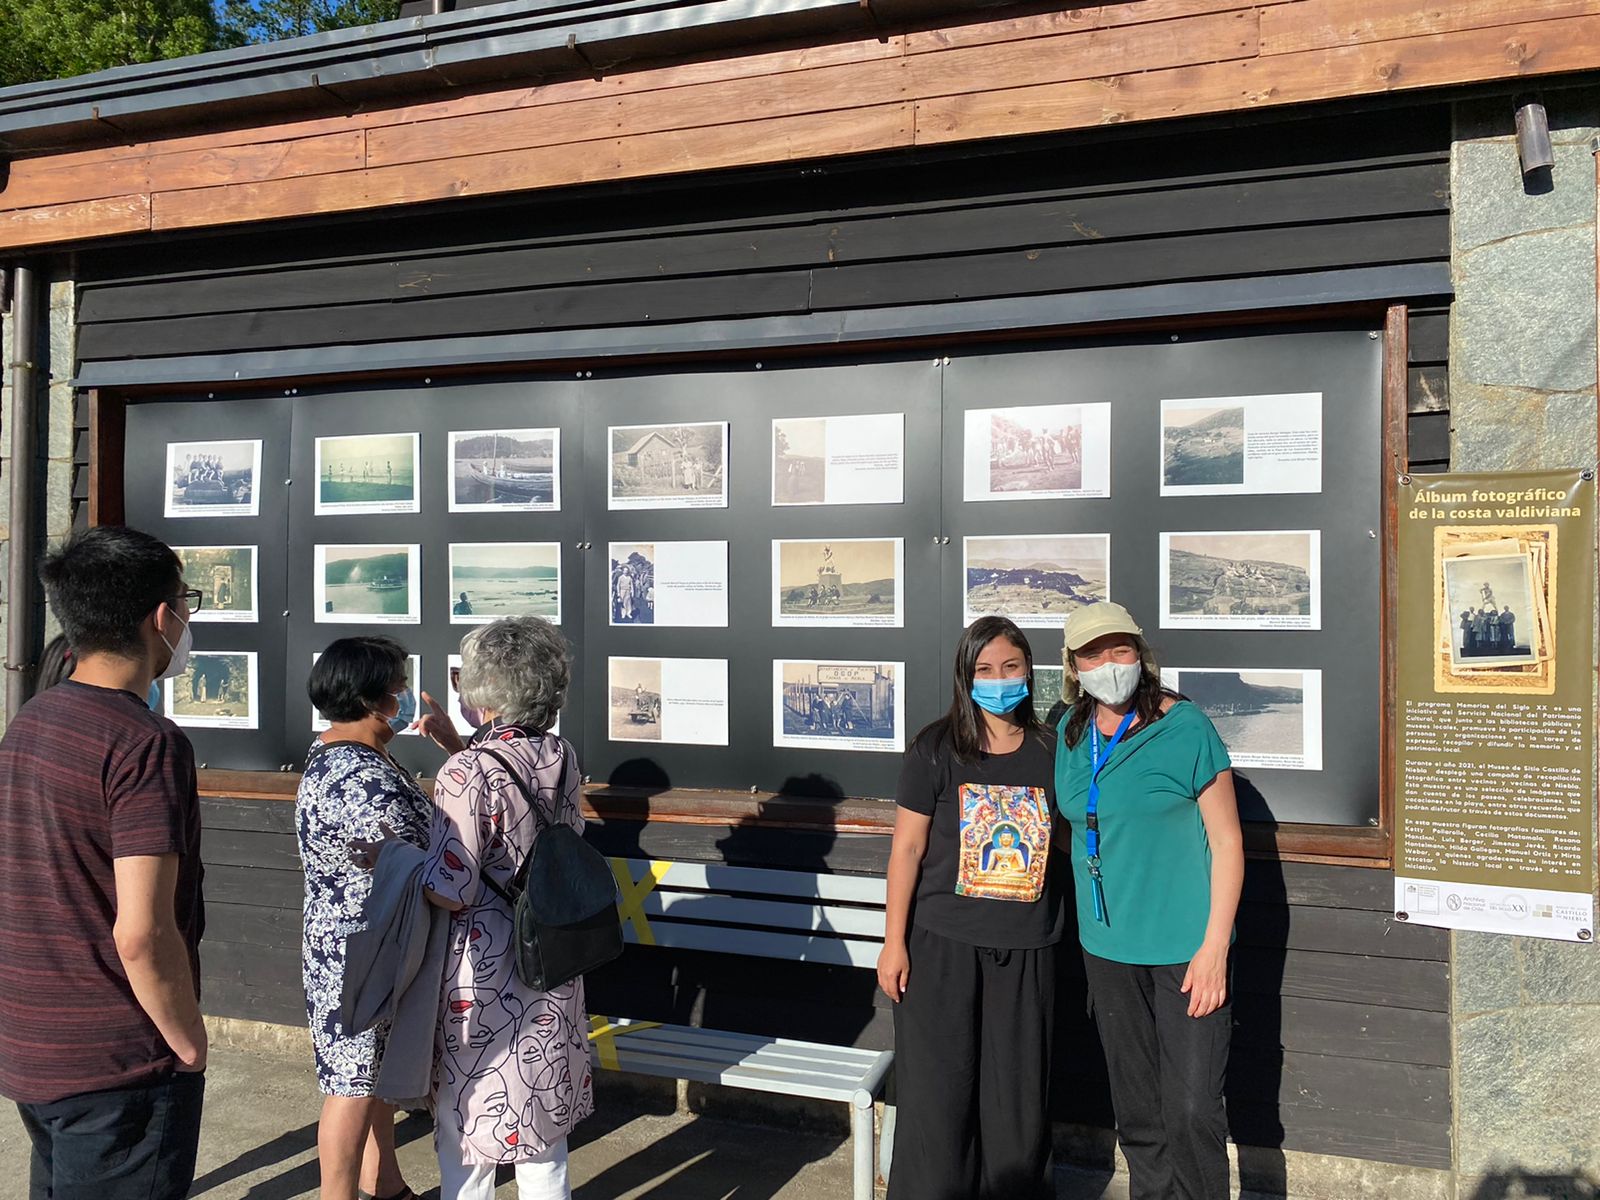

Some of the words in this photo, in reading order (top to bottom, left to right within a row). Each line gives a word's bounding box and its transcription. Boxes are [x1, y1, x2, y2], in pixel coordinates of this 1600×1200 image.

[1415, 489, 1466, 503] Álbum
[1472, 488, 1566, 504] fotográfico
[1410, 508, 1427, 518] de
[1432, 508, 1444, 518] la
[1450, 509, 1491, 518] costa
[1496, 506, 1580, 517] valdiviana
